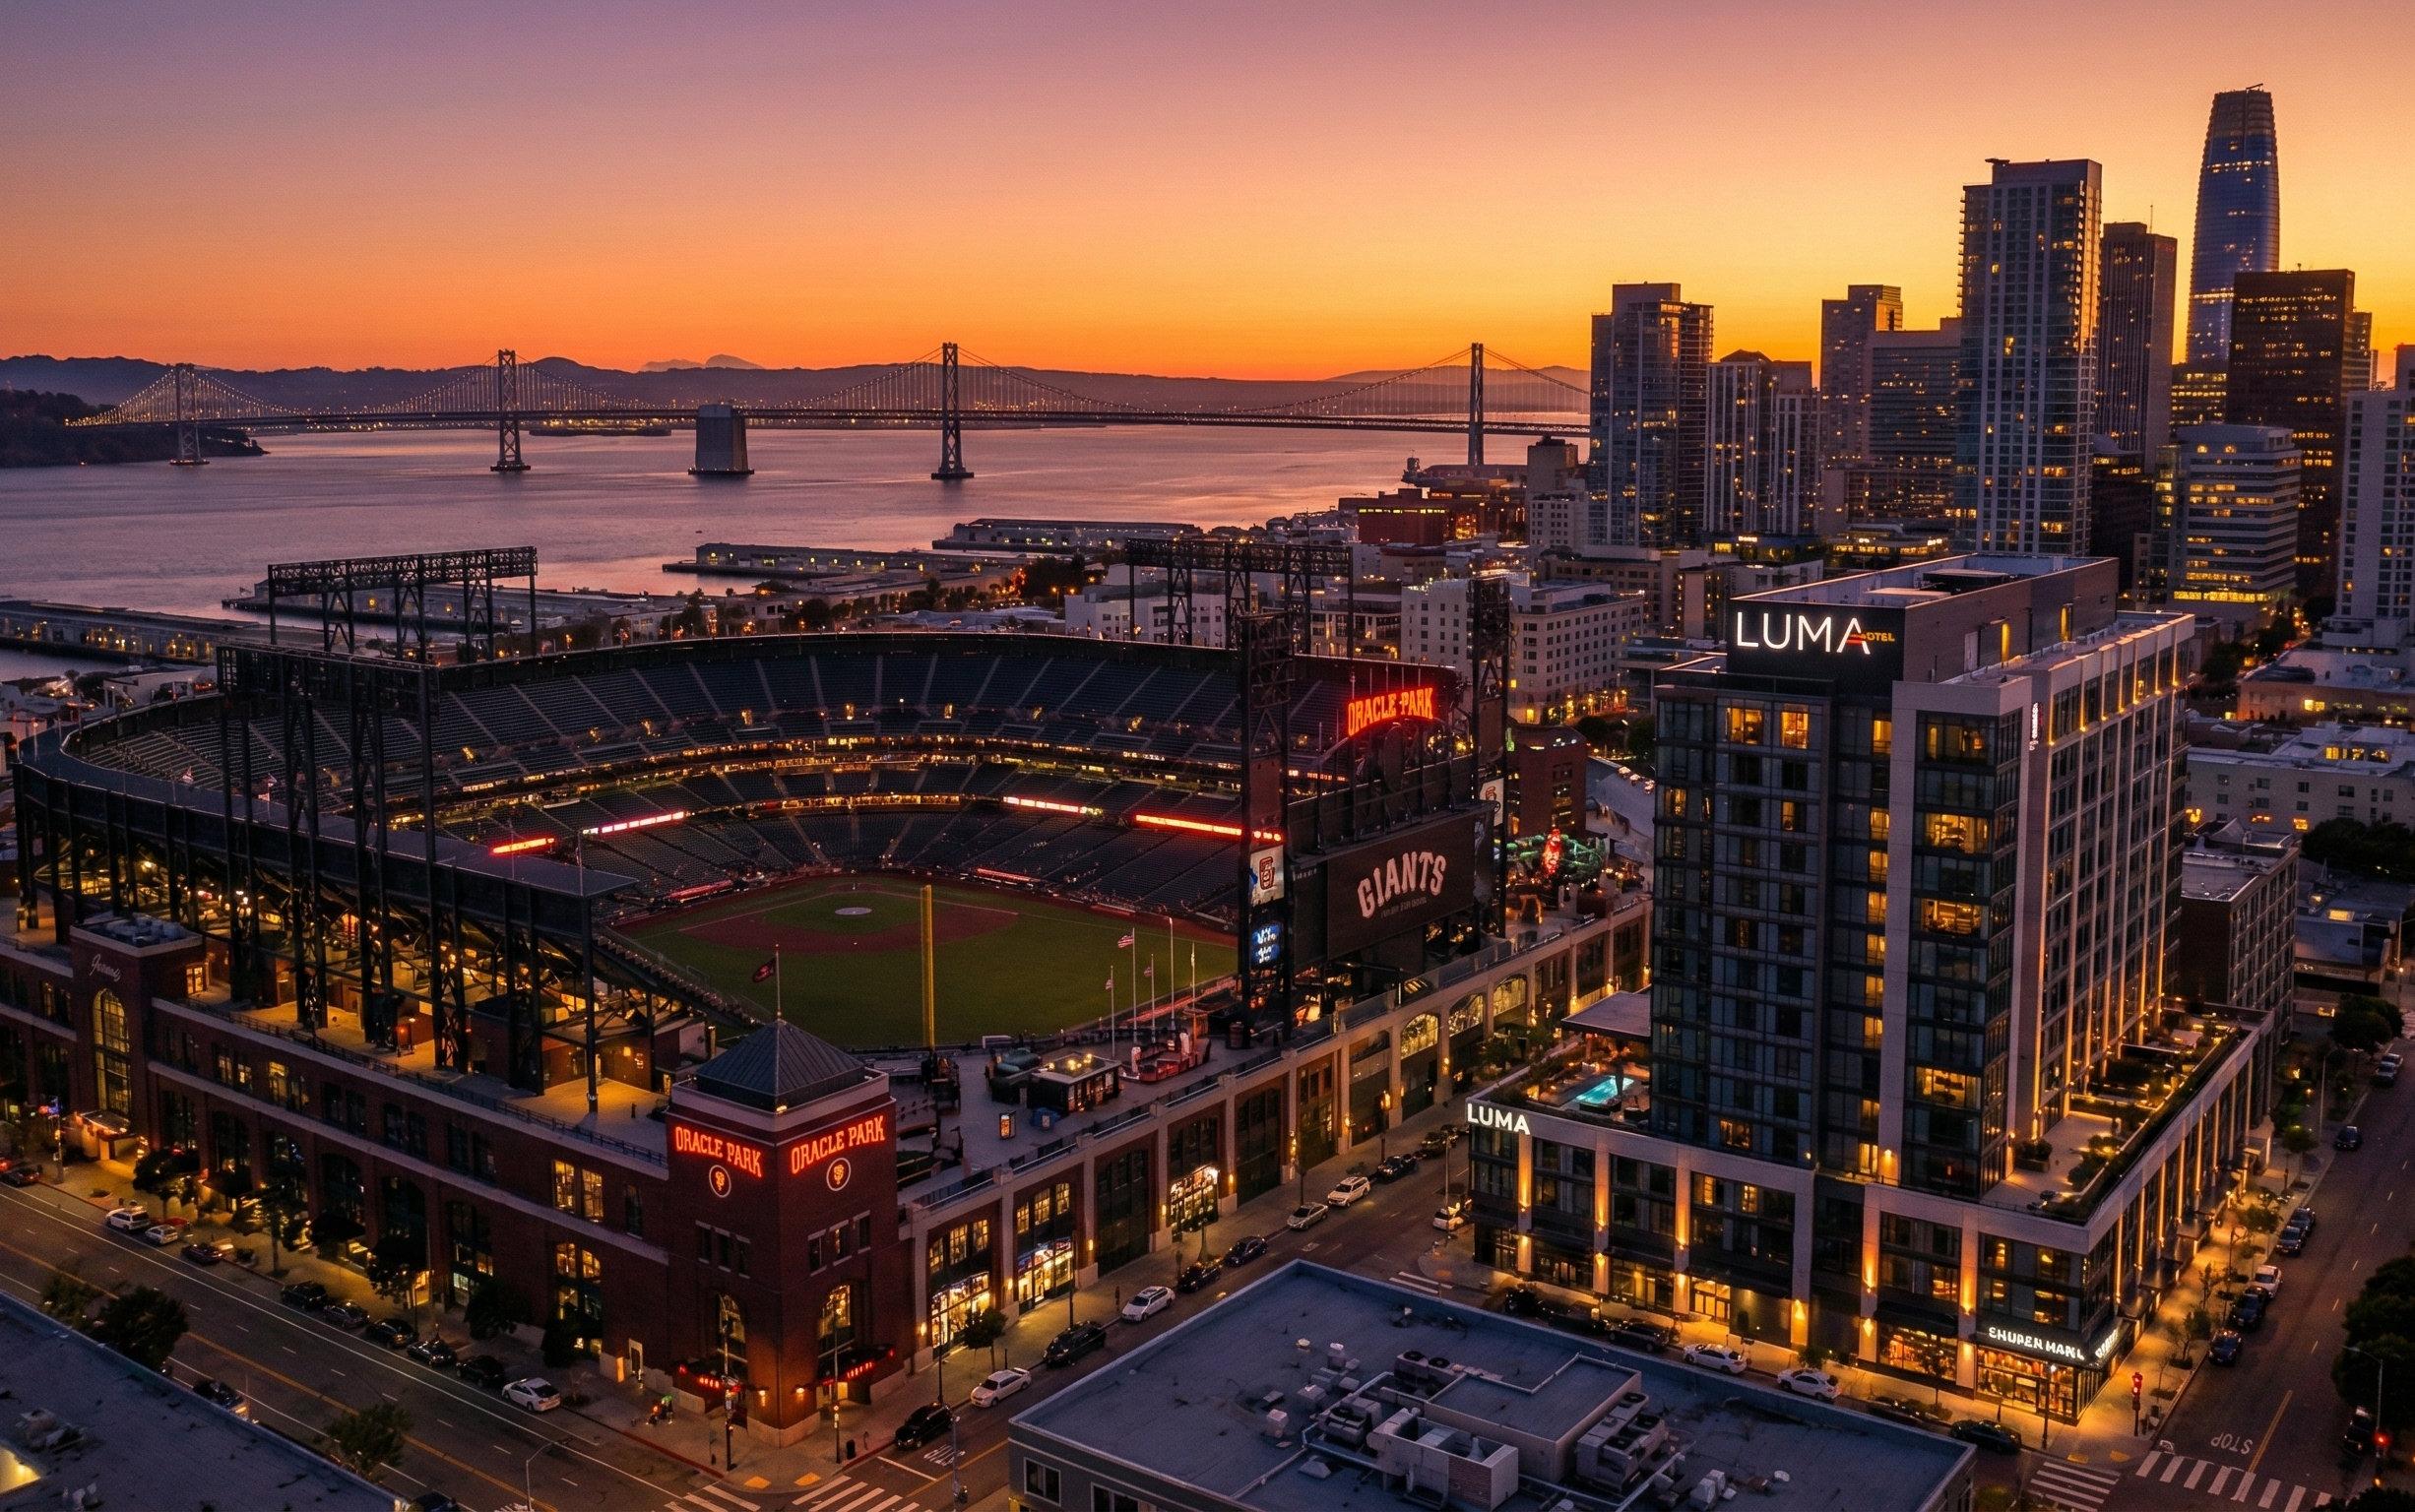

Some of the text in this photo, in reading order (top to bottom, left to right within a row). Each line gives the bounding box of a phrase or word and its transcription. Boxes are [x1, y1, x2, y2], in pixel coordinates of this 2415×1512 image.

[1736, 611, 1871, 655] LUMA
[1348, 687, 1433, 736] ORACLE PARK
[1357, 850, 1447, 919] GIANTS
[1467, 1102, 1531, 1135] LUMA
[675, 1126, 762, 1177] ORACLE PARK
[792, 1114, 885, 1174] ORACLE PARK
[2210, 1432, 2254, 1455] STOP
